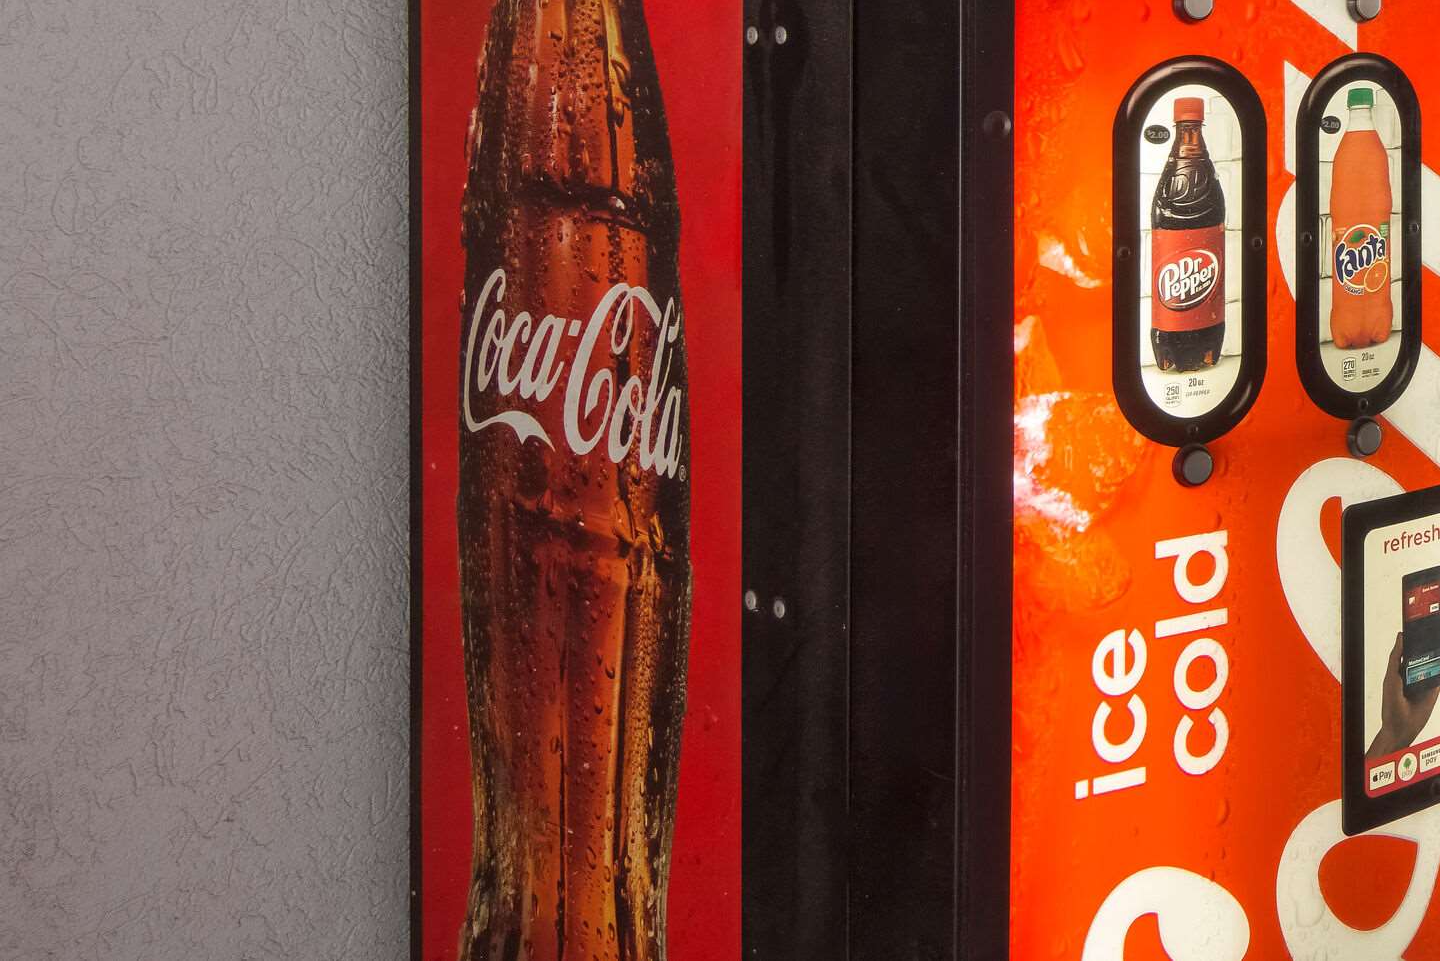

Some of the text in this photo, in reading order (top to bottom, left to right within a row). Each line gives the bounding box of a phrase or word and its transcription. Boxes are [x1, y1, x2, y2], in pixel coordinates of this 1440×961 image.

[1335, 233, 1386, 286] Fanta
[1178, 257, 1203, 281] Dr
[1159, 262, 1215, 301] Pepper
[463, 268, 683, 474] Coca-Cola
[1343, 360, 1355, 370] 270
[1166, 386, 1180, 396] 250
[1189, 378, 1198, 387] 20
[1154, 529, 1229, 776] cold
[1074, 627, 1148, 800] ice
[1421, 749, 1440, 759] SAMSUNG
[1425, 757, 1437, 766] pay
[1379, 770, 1393, 780] Pay
